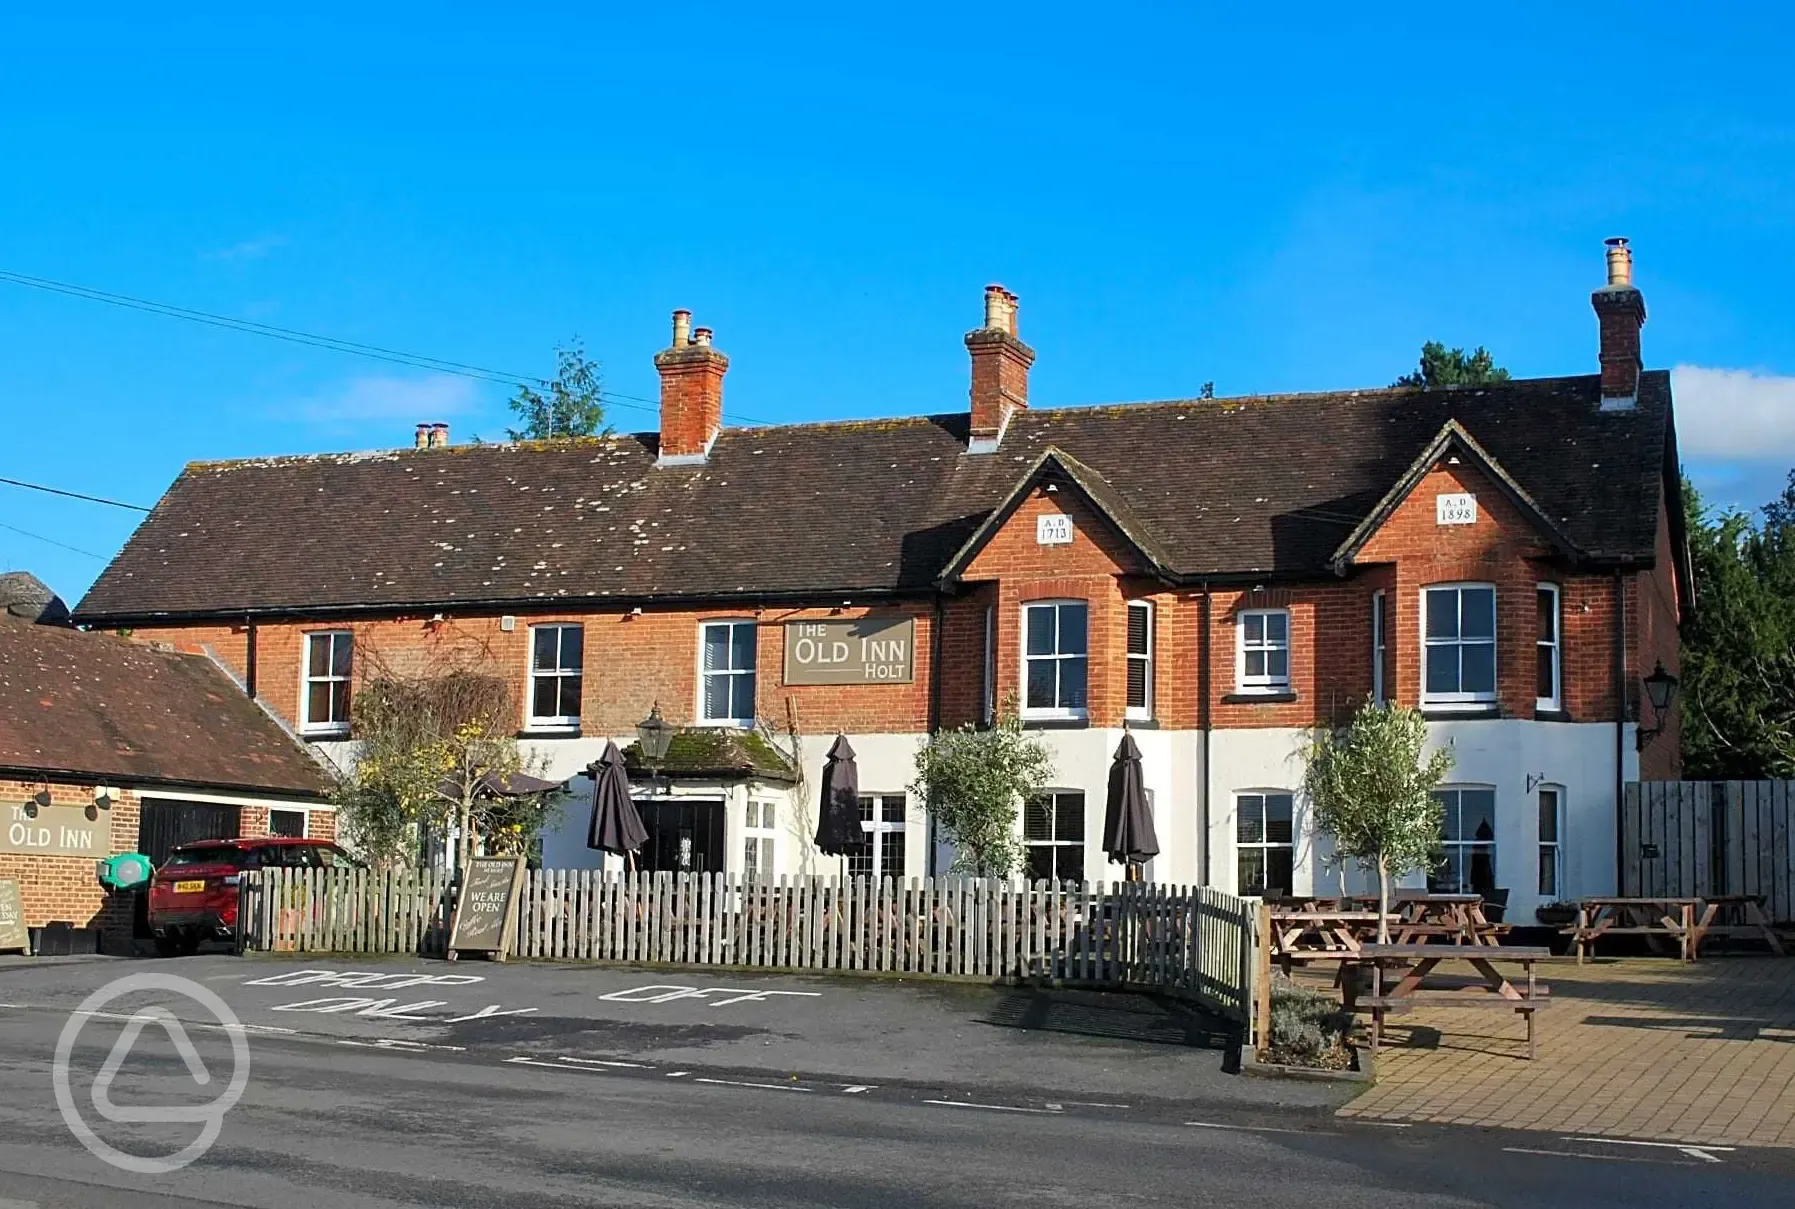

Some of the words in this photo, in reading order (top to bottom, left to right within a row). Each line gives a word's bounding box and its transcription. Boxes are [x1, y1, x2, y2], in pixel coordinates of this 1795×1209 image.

[1442, 509, 1471, 520] 1898
[1042, 528, 1067, 540] 1713
[798, 622, 827, 637] THE
[795, 638, 849, 663] OLD
[860, 637, 905, 662] INN
[865, 663, 905, 678] HOLT
[11, 806, 35, 821] TH
[9, 822, 51, 847] OLD
[60, 825, 92, 849] INN
[471, 892, 486, 902] WE
[487, 892, 506, 902] ARE
[472, 902, 500, 912] OPEN
[243, 970, 486, 989] DROP
[598, 985, 822, 1006] OFF
[271, 997, 539, 1022] ONLY
